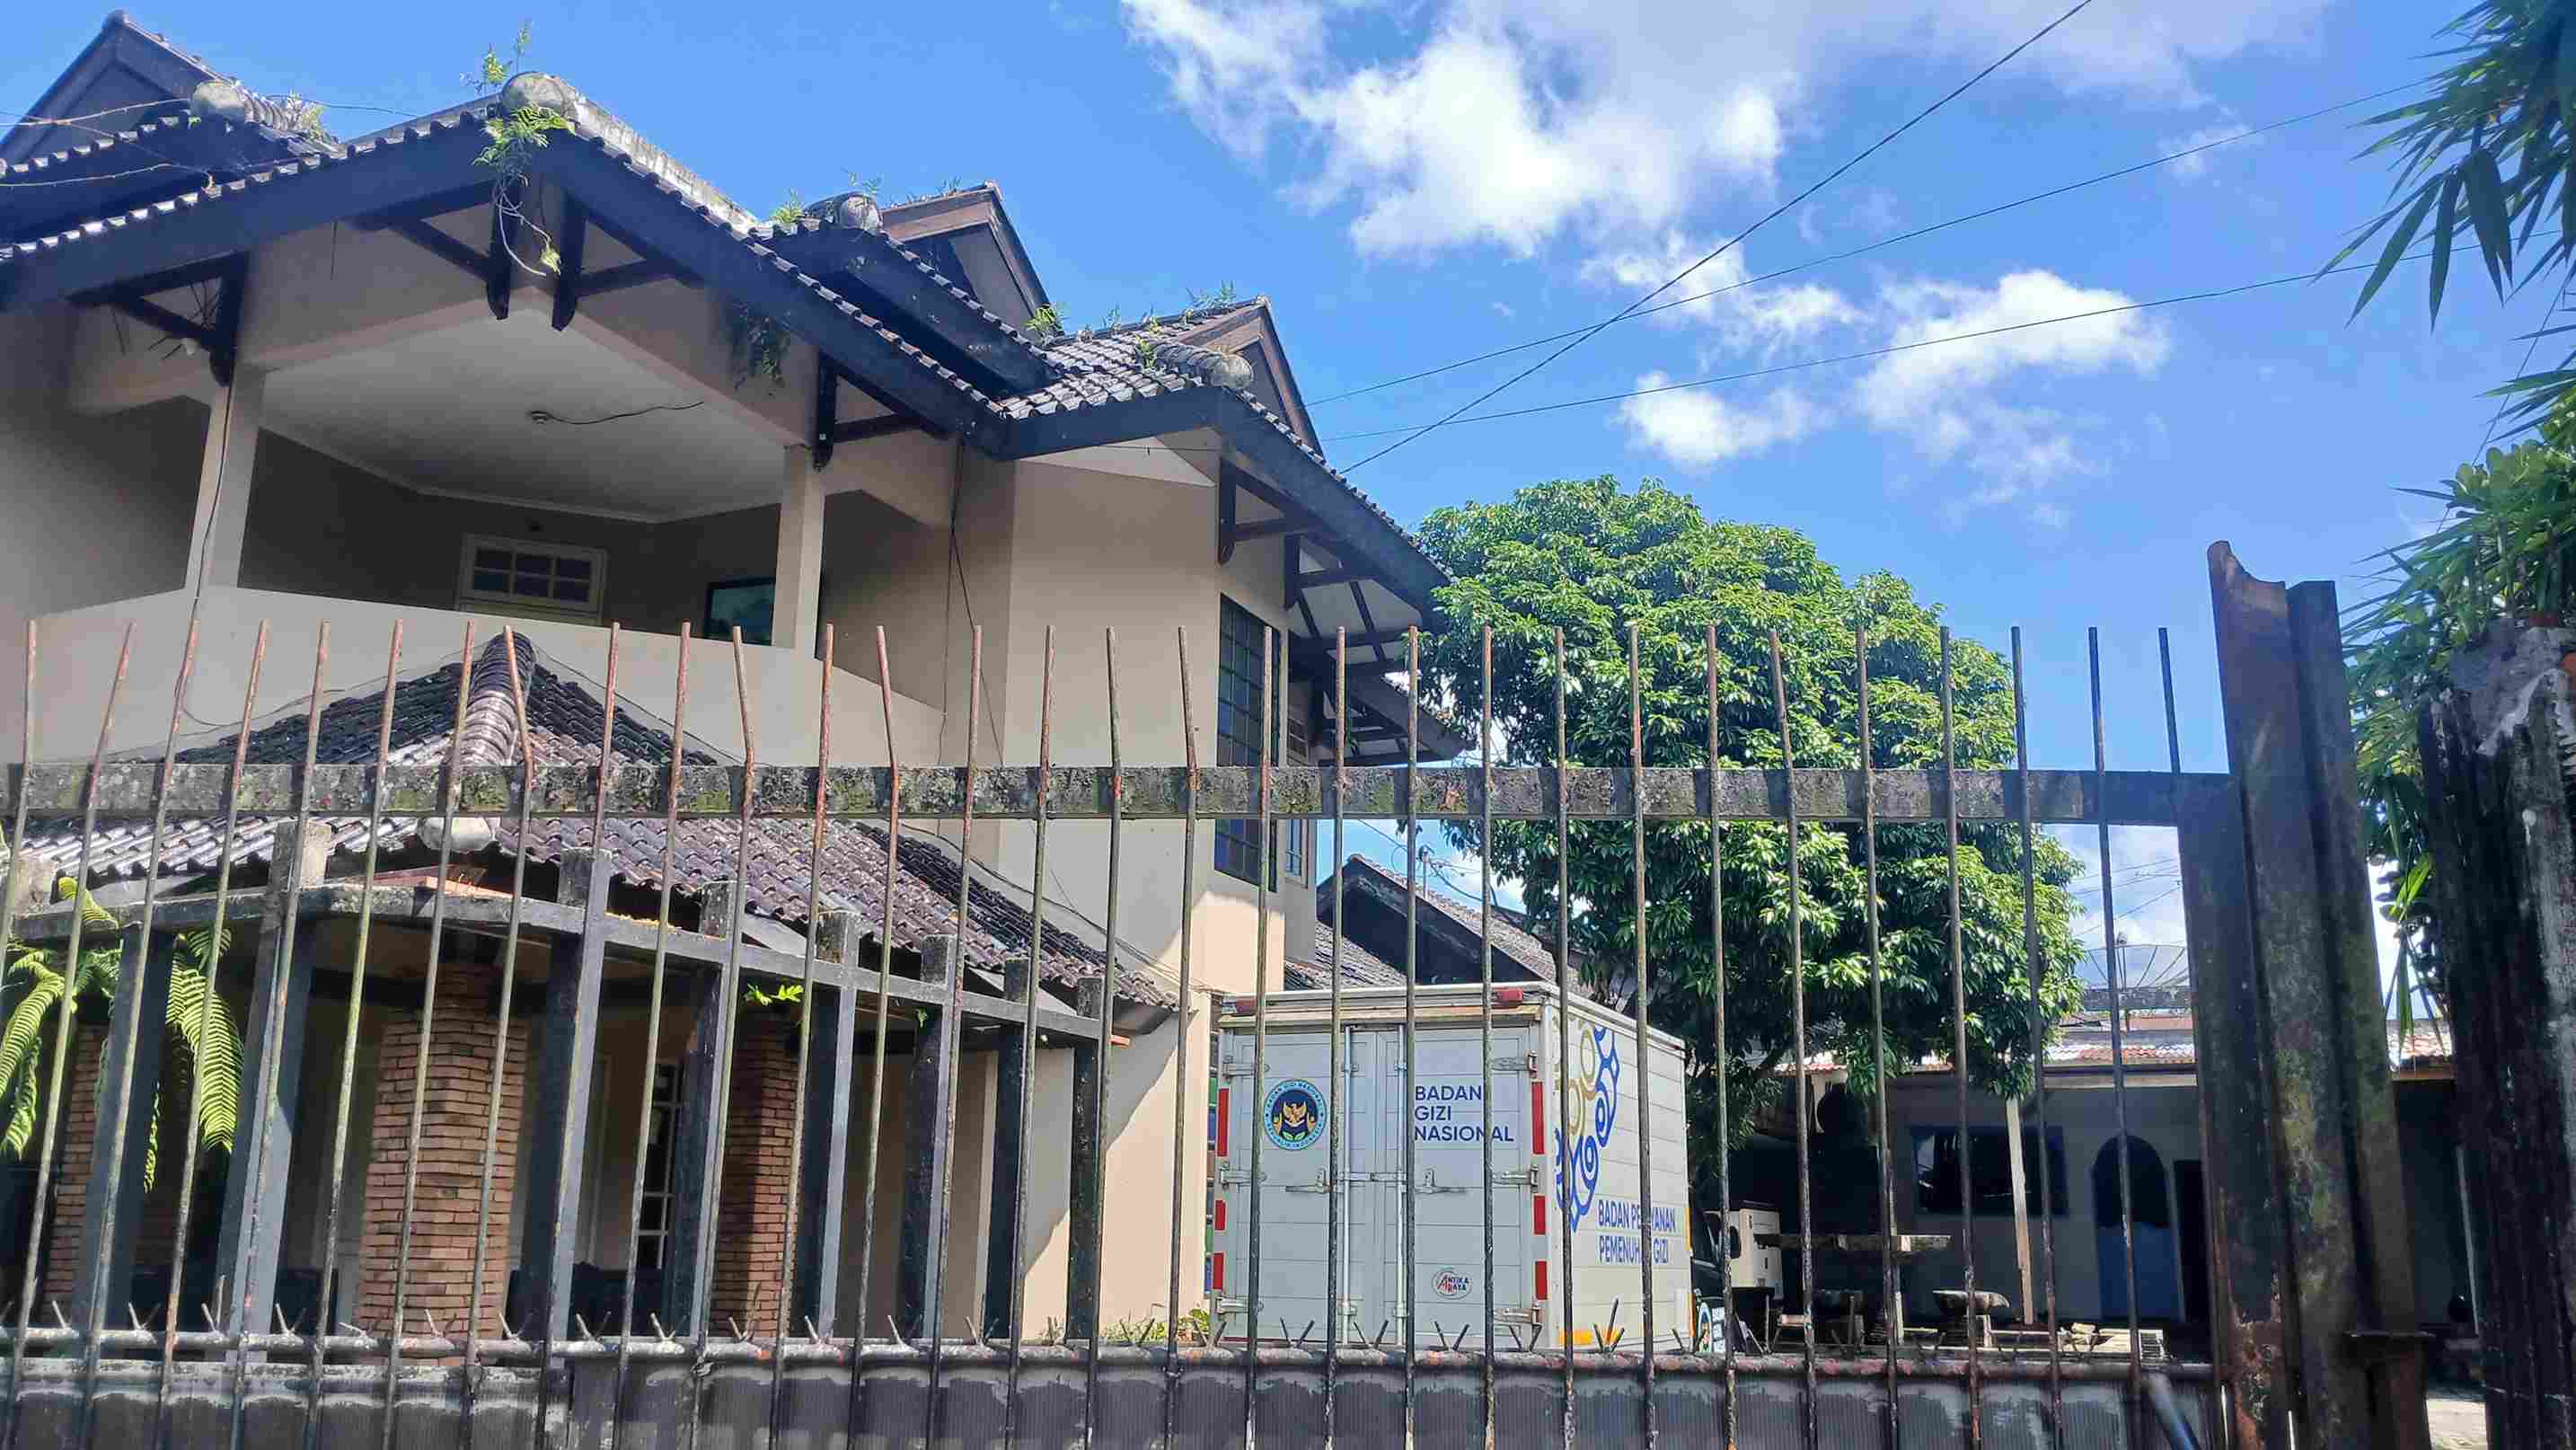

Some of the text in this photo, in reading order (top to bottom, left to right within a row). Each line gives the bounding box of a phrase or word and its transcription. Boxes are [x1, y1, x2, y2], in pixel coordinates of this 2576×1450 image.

[1416, 1085, 1482, 1101] BADAN
[1415, 1106, 1451, 1121] GIZI
[1415, 1126, 1514, 1142] NASIONAL
[1599, 1199, 1629, 1229] BADAN
[1600, 1235, 1644, 1263] PEMENUH
